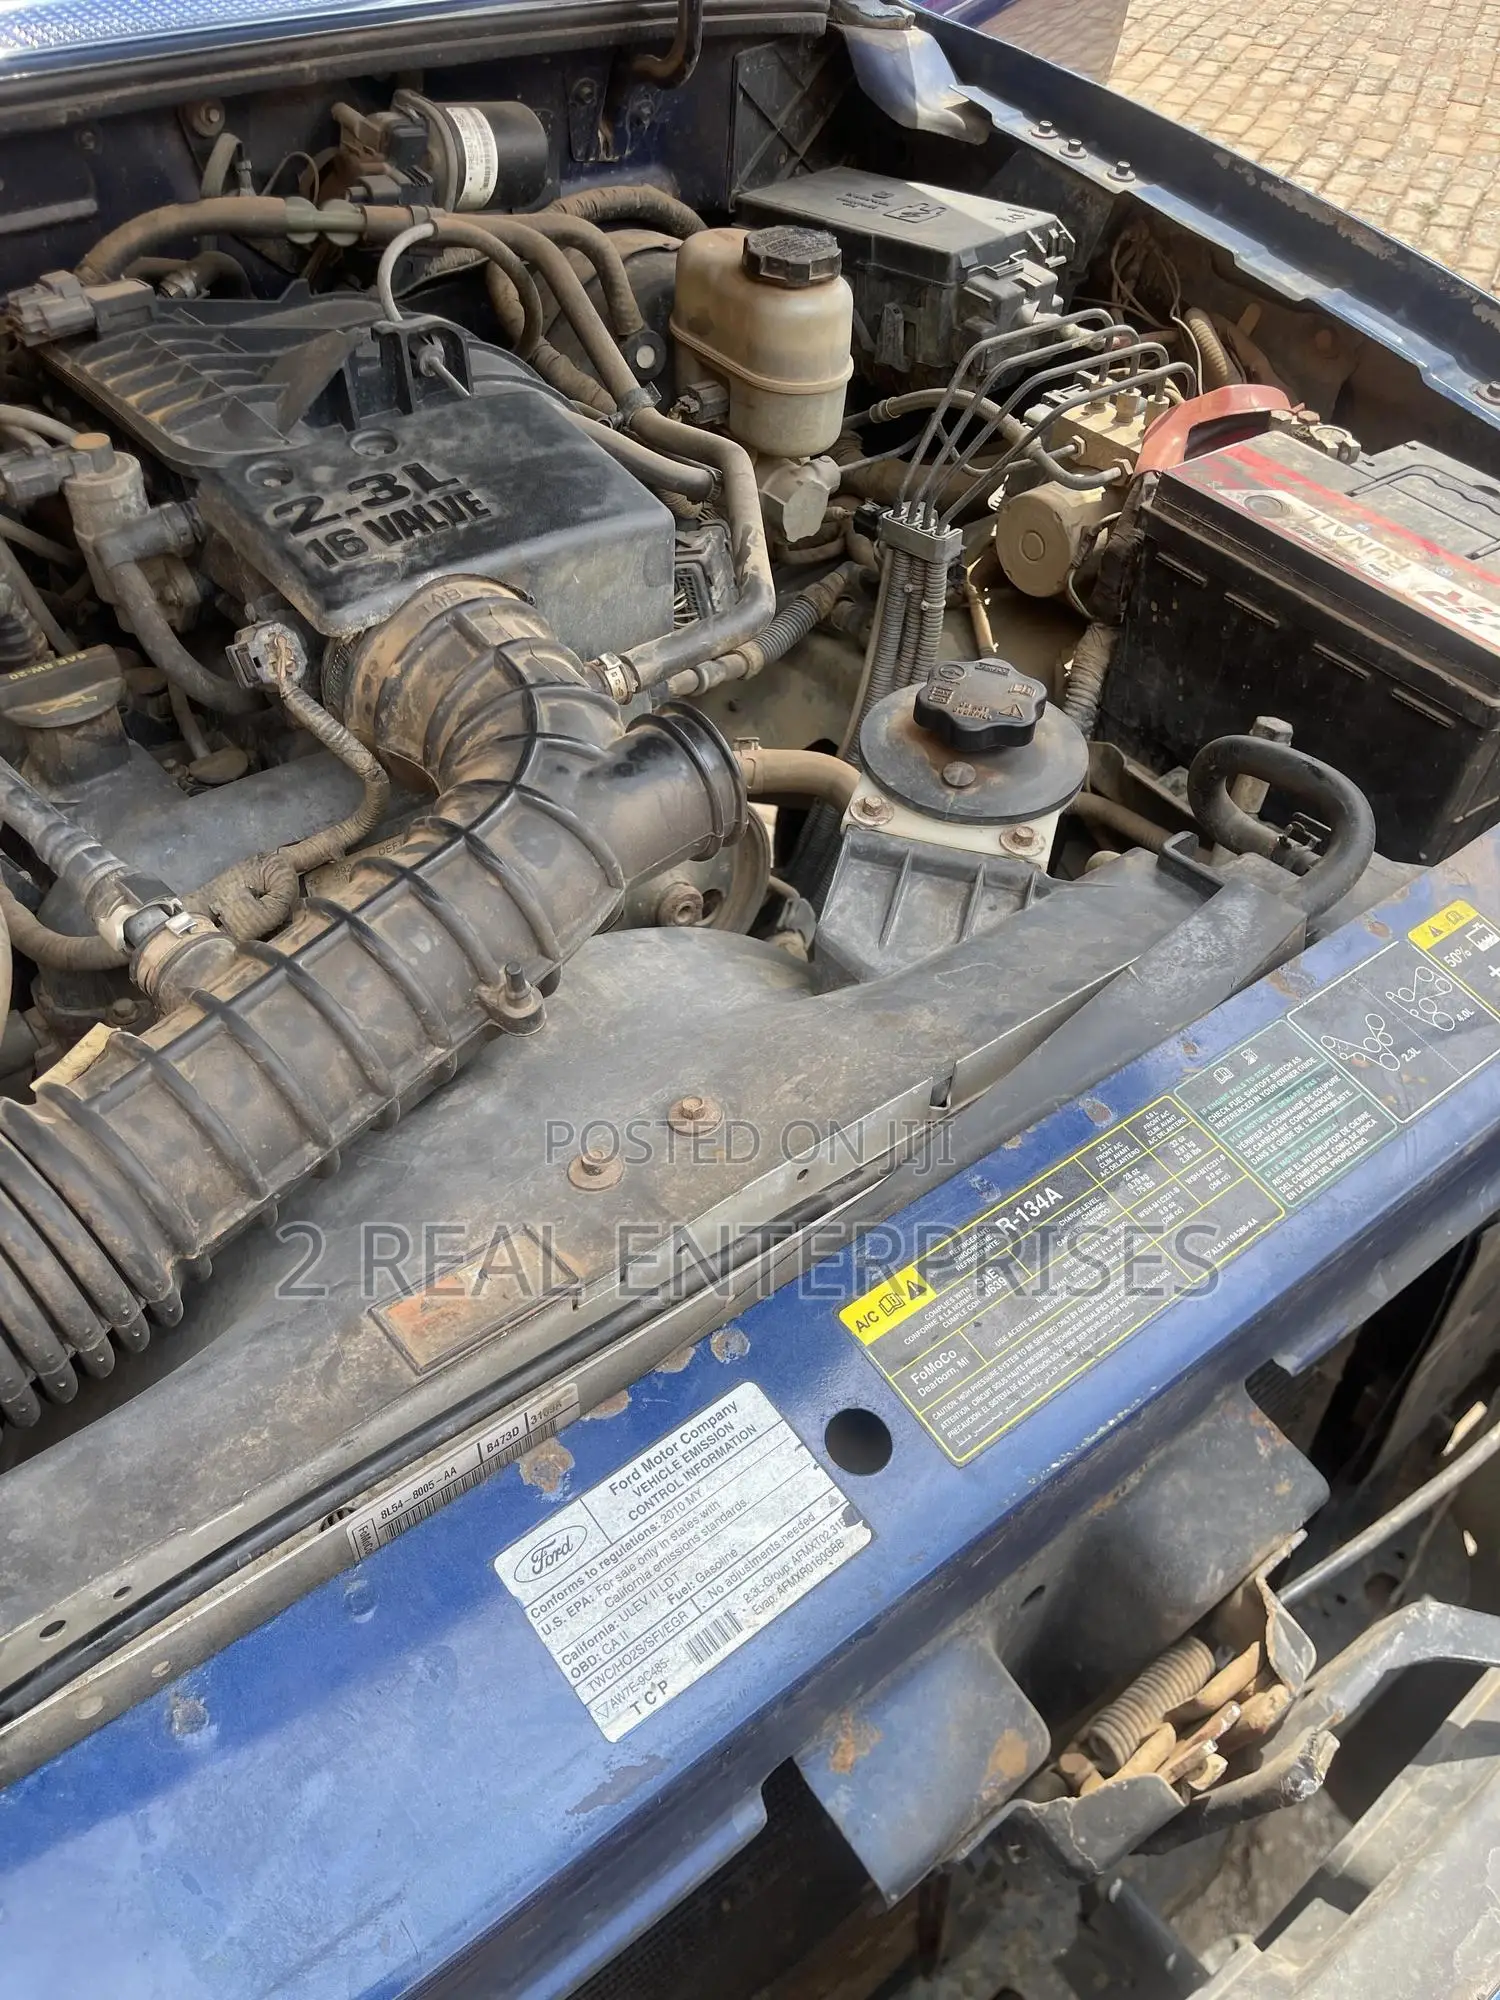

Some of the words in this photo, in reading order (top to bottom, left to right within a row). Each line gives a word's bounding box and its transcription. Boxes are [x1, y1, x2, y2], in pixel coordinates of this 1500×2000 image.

[273, 462, 462, 535] 2.3L
[305, 528, 369, 568] 16
[363, 490, 491, 546] VALVE
[1443, 945, 1472, 968] 50%
[1228, 1094, 1246, 1108] FUEL
[1243, 1076, 1272, 1097] SHUTOFF
[1259, 1083, 1278, 1097] YOUR
[994, 1184, 1063, 1236] R-134A
[974, 1268, 998, 1288] SAE
[982, 1276, 1007, 1297] J639
[853, 1310, 880, 1332] A/C
[910, 1347, 957, 1384] FoMoCo
[917, 1364, 959, 1397] Dearborn,
[957, 1357, 969, 1368] MI
[487, 1426, 519, 1453] B473D
[609, 1466, 644, 1495] Ford
[640, 1440, 681, 1473] Motor
[678, 1399, 740, 1447] Company
[627, 1477, 684, 1521] CONTROL
[682, 1424, 757, 1481] INFORMATION
[632, 1459, 681, 1497] VEHICLE
[681, 1421, 735, 1462] EMISSION
[529, 1575, 585, 1619] Conforms
[584, 1565, 598, 1579] to
[597, 1520, 662, 1571] regulations:
[659, 1501, 686, 1523] 2010
[685, 1488, 703, 1505] MY
[531, 1533, 574, 1576] Ford
[541, 1613, 566, 1635] U.S.
[566, 1592, 594, 1617] EPA:
[595, 1577, 614, 1595] For
[613, 1561, 636, 1581] sale
[636, 1545, 660, 1567] only
[659, 1537, 670, 1548] in
[668, 1515, 700, 1541] states
[698, 1500, 720, 1519] with
[603, 1569, 652, 1608] California
[651, 1533, 701, 1573] emissions
[707, 1581, 725, 1600] No
[723, 1539, 782, 1588] adjustments
[779, 1512, 816, 1542] needed
[561, 1619, 619, 1666] California:
[618, 1595, 650, 1622] ULEV
[648, 1588, 658, 1599] II
[658, 1570, 681, 1592] LDT
[569, 1651, 601, 1679] OBD:
[601, 1637, 620, 1655] CA
[620, 1630, 628, 1640] II
[667, 1580, 695, 1604] Fuel:
[694, 1547, 738, 1584] Gasoline
[586, 1610, 689, 1692] TWC/HO2S/SFI/EGR
